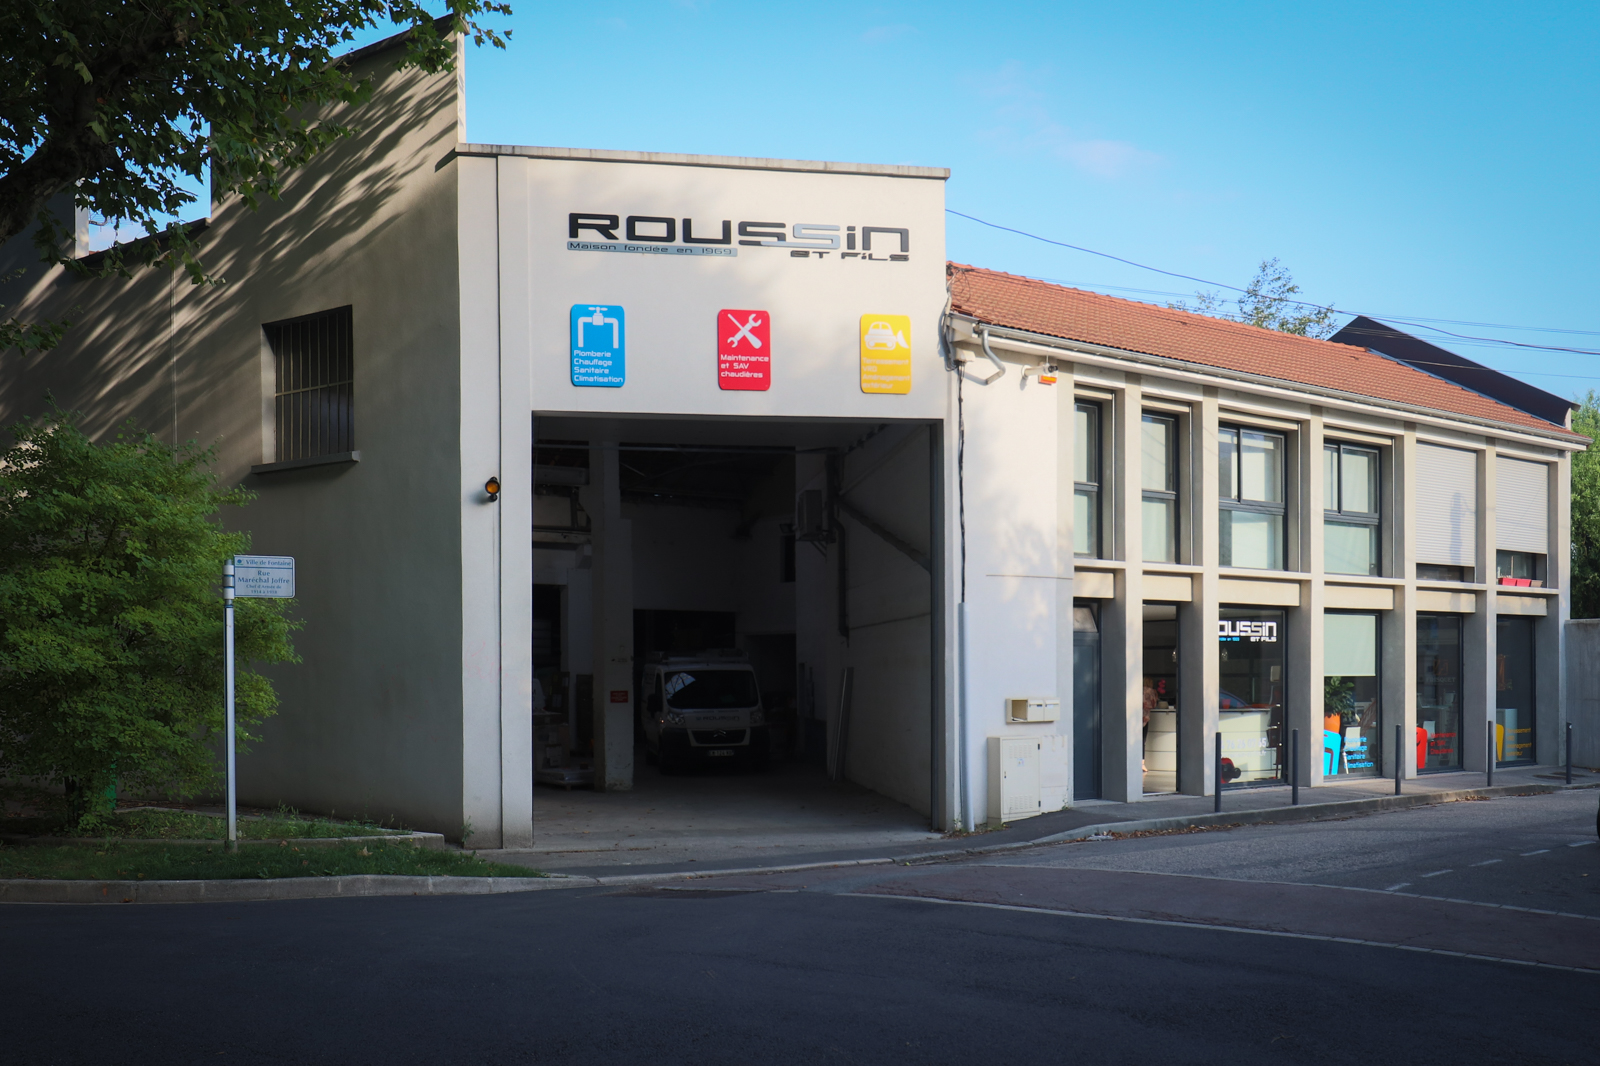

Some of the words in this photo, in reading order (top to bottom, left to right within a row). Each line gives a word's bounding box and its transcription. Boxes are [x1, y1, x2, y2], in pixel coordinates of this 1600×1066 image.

[570, 242, 616, 250] Maison
[574, 358, 612, 367] Chauffage
[862, 374, 910, 382] Aménagement
